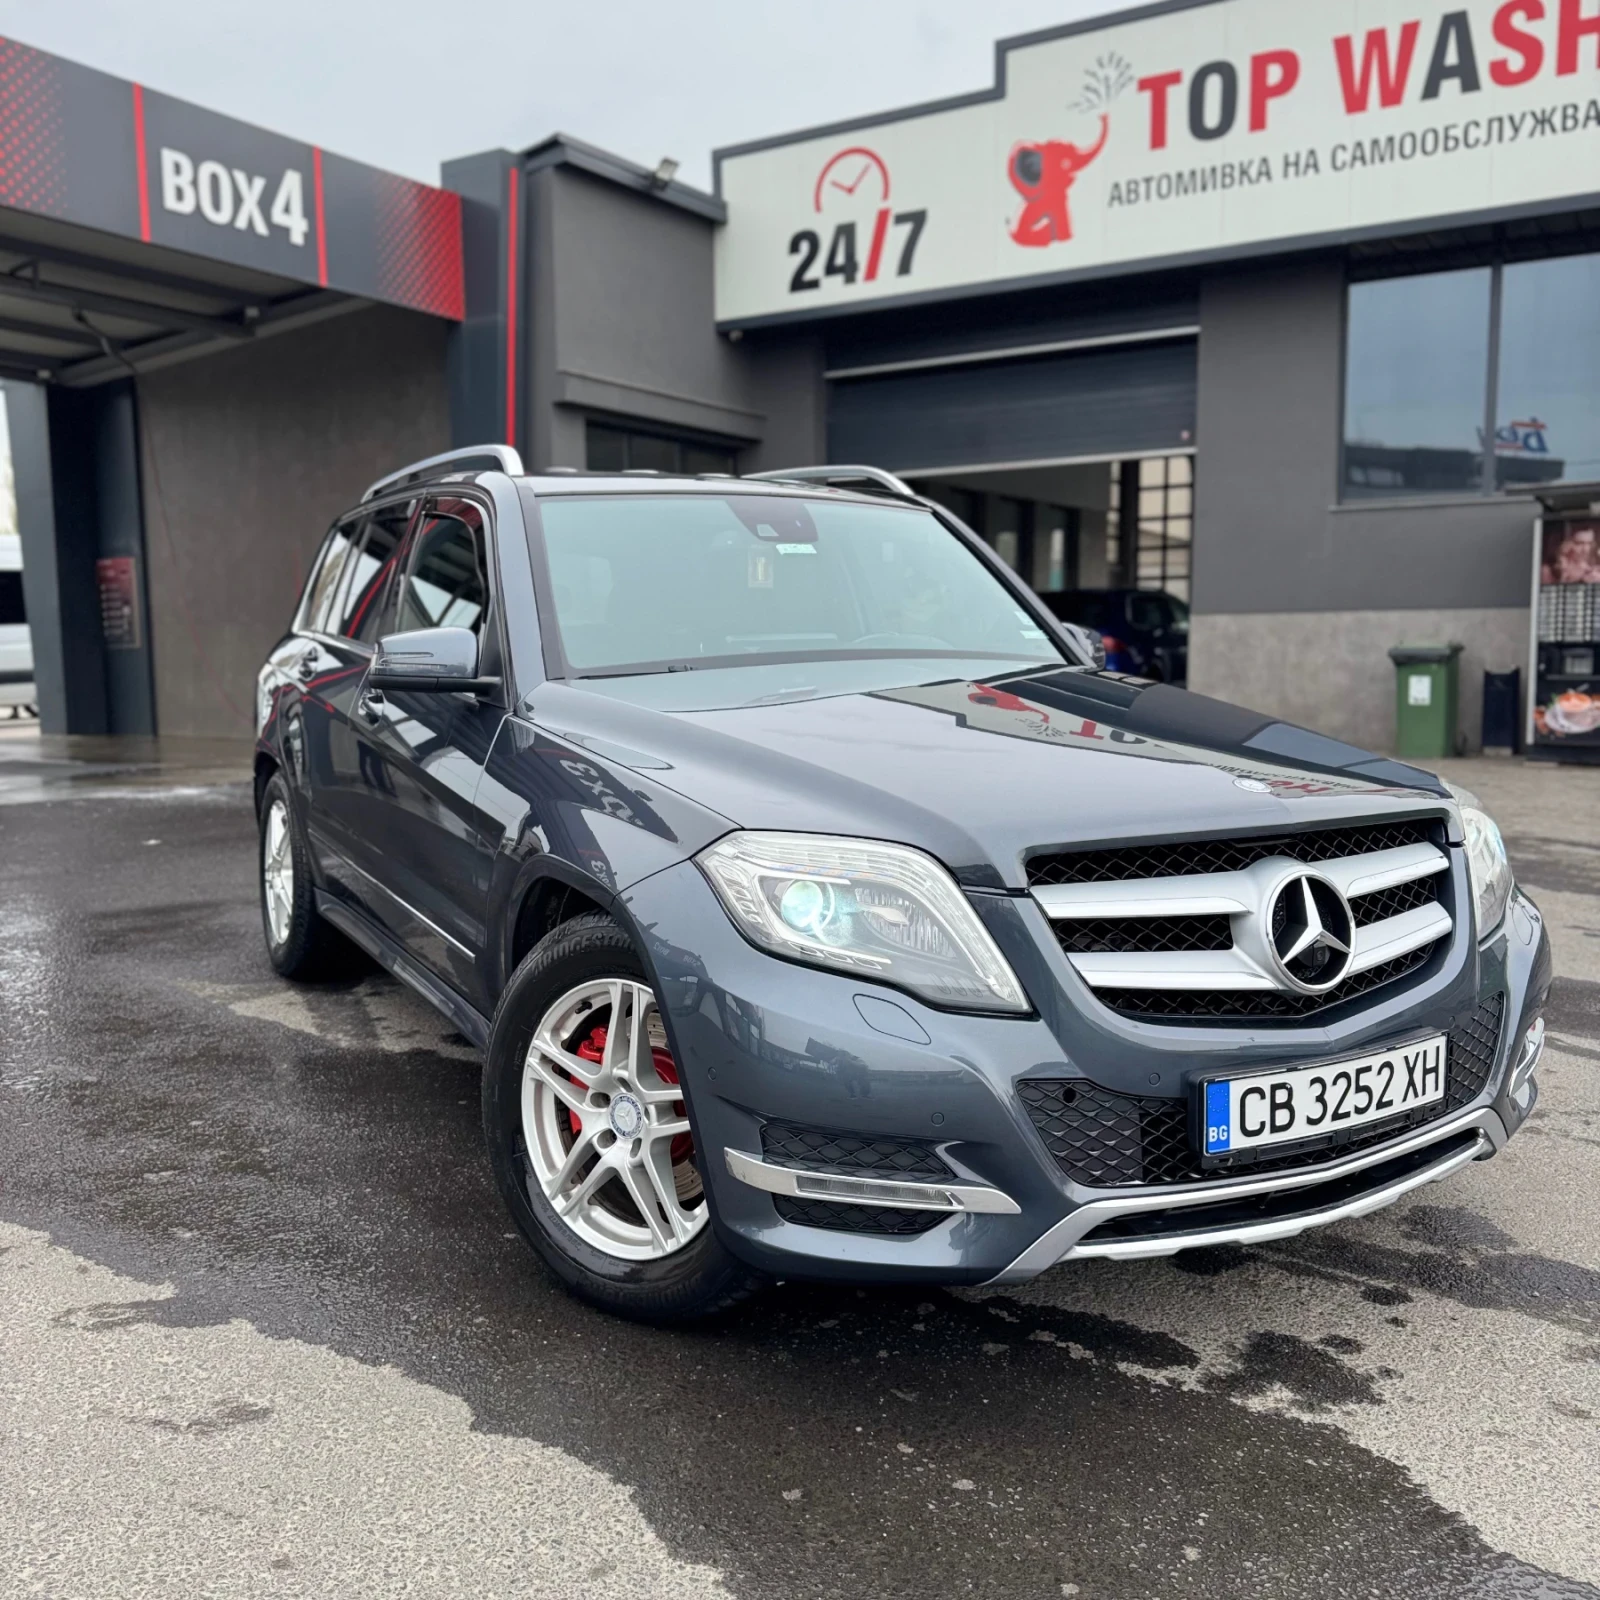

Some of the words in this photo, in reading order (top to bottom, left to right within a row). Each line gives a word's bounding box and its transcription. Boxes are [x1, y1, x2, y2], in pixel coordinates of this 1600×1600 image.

[1137, 48, 1301, 151] TOP
[1333, 0, 1600, 116] WASH
[1108, 155, 1273, 208] АВТОМИВКА
[1282, 148, 1321, 179] НА
[1331, 98, 1600, 172] САМООБСЛУЖВА
[787, 207, 929, 294] 24/7
[1208, 1124, 1228, 1144] BG
[1239, 1081, 1296, 1138] CB
[1306, 1060, 1395, 1126] 3252
[1401, 1045, 1441, 1105] XH
